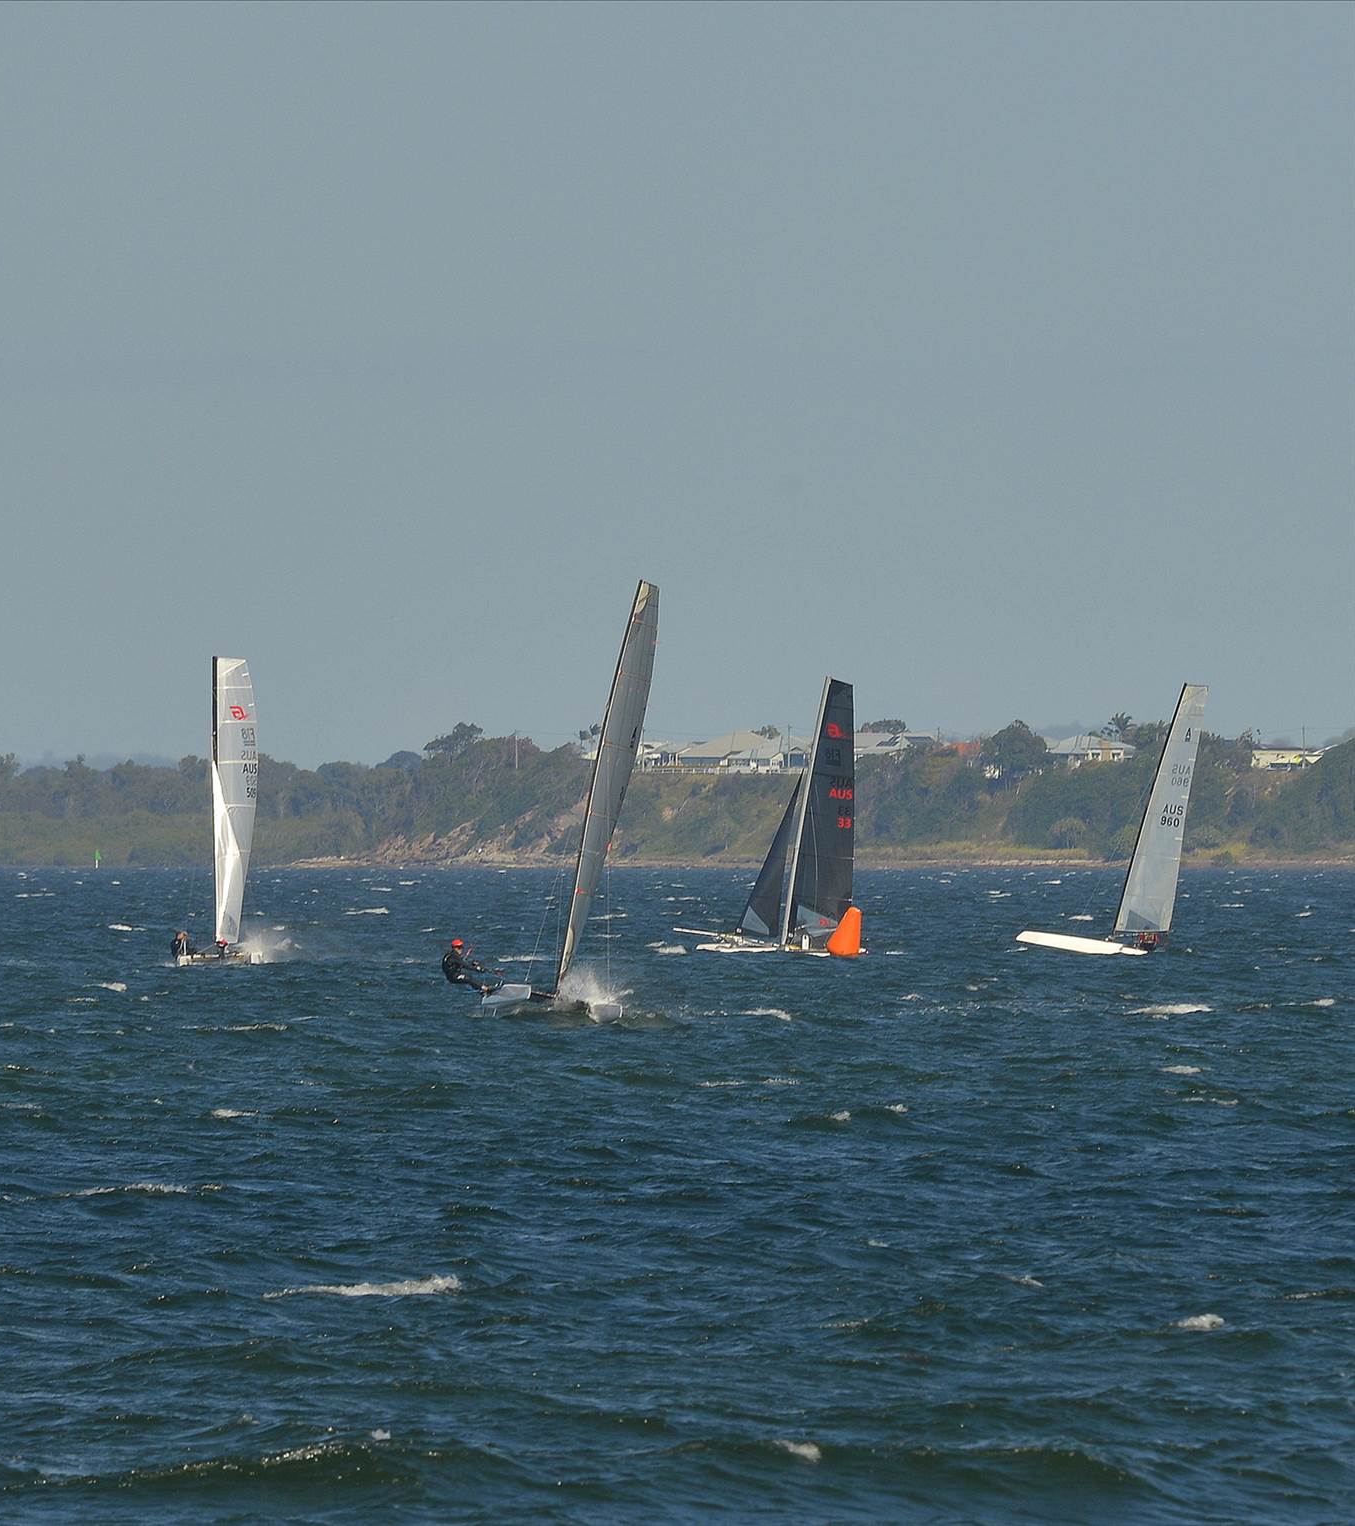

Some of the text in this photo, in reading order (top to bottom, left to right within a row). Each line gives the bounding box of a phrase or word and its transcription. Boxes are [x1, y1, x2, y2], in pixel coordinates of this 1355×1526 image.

[243, 763, 258, 774] AUS
[829, 788, 853, 800] AUS
[1162, 803, 1184, 816] AUS
[837, 817, 852, 829] 33
[1160, 815, 1180, 828] 960
